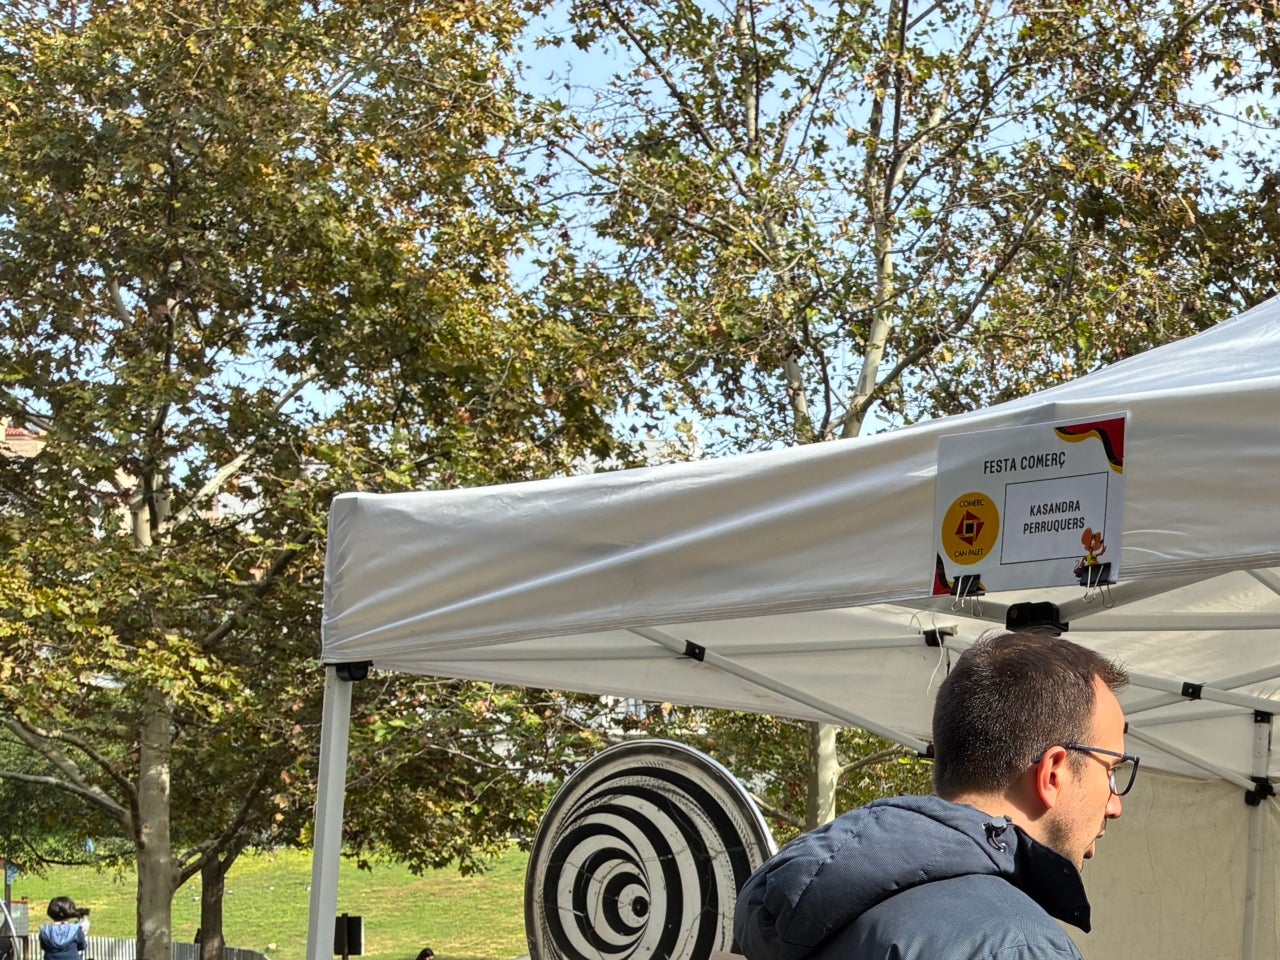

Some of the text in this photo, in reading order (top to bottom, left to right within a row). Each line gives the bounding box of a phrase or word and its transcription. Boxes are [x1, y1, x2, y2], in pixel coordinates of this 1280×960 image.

[983, 451, 1067, 475] FESTA COMERÇ
[1029, 499, 1081, 517] KASANDRA
[1023, 516, 1085, 535] PERRUQUERS
